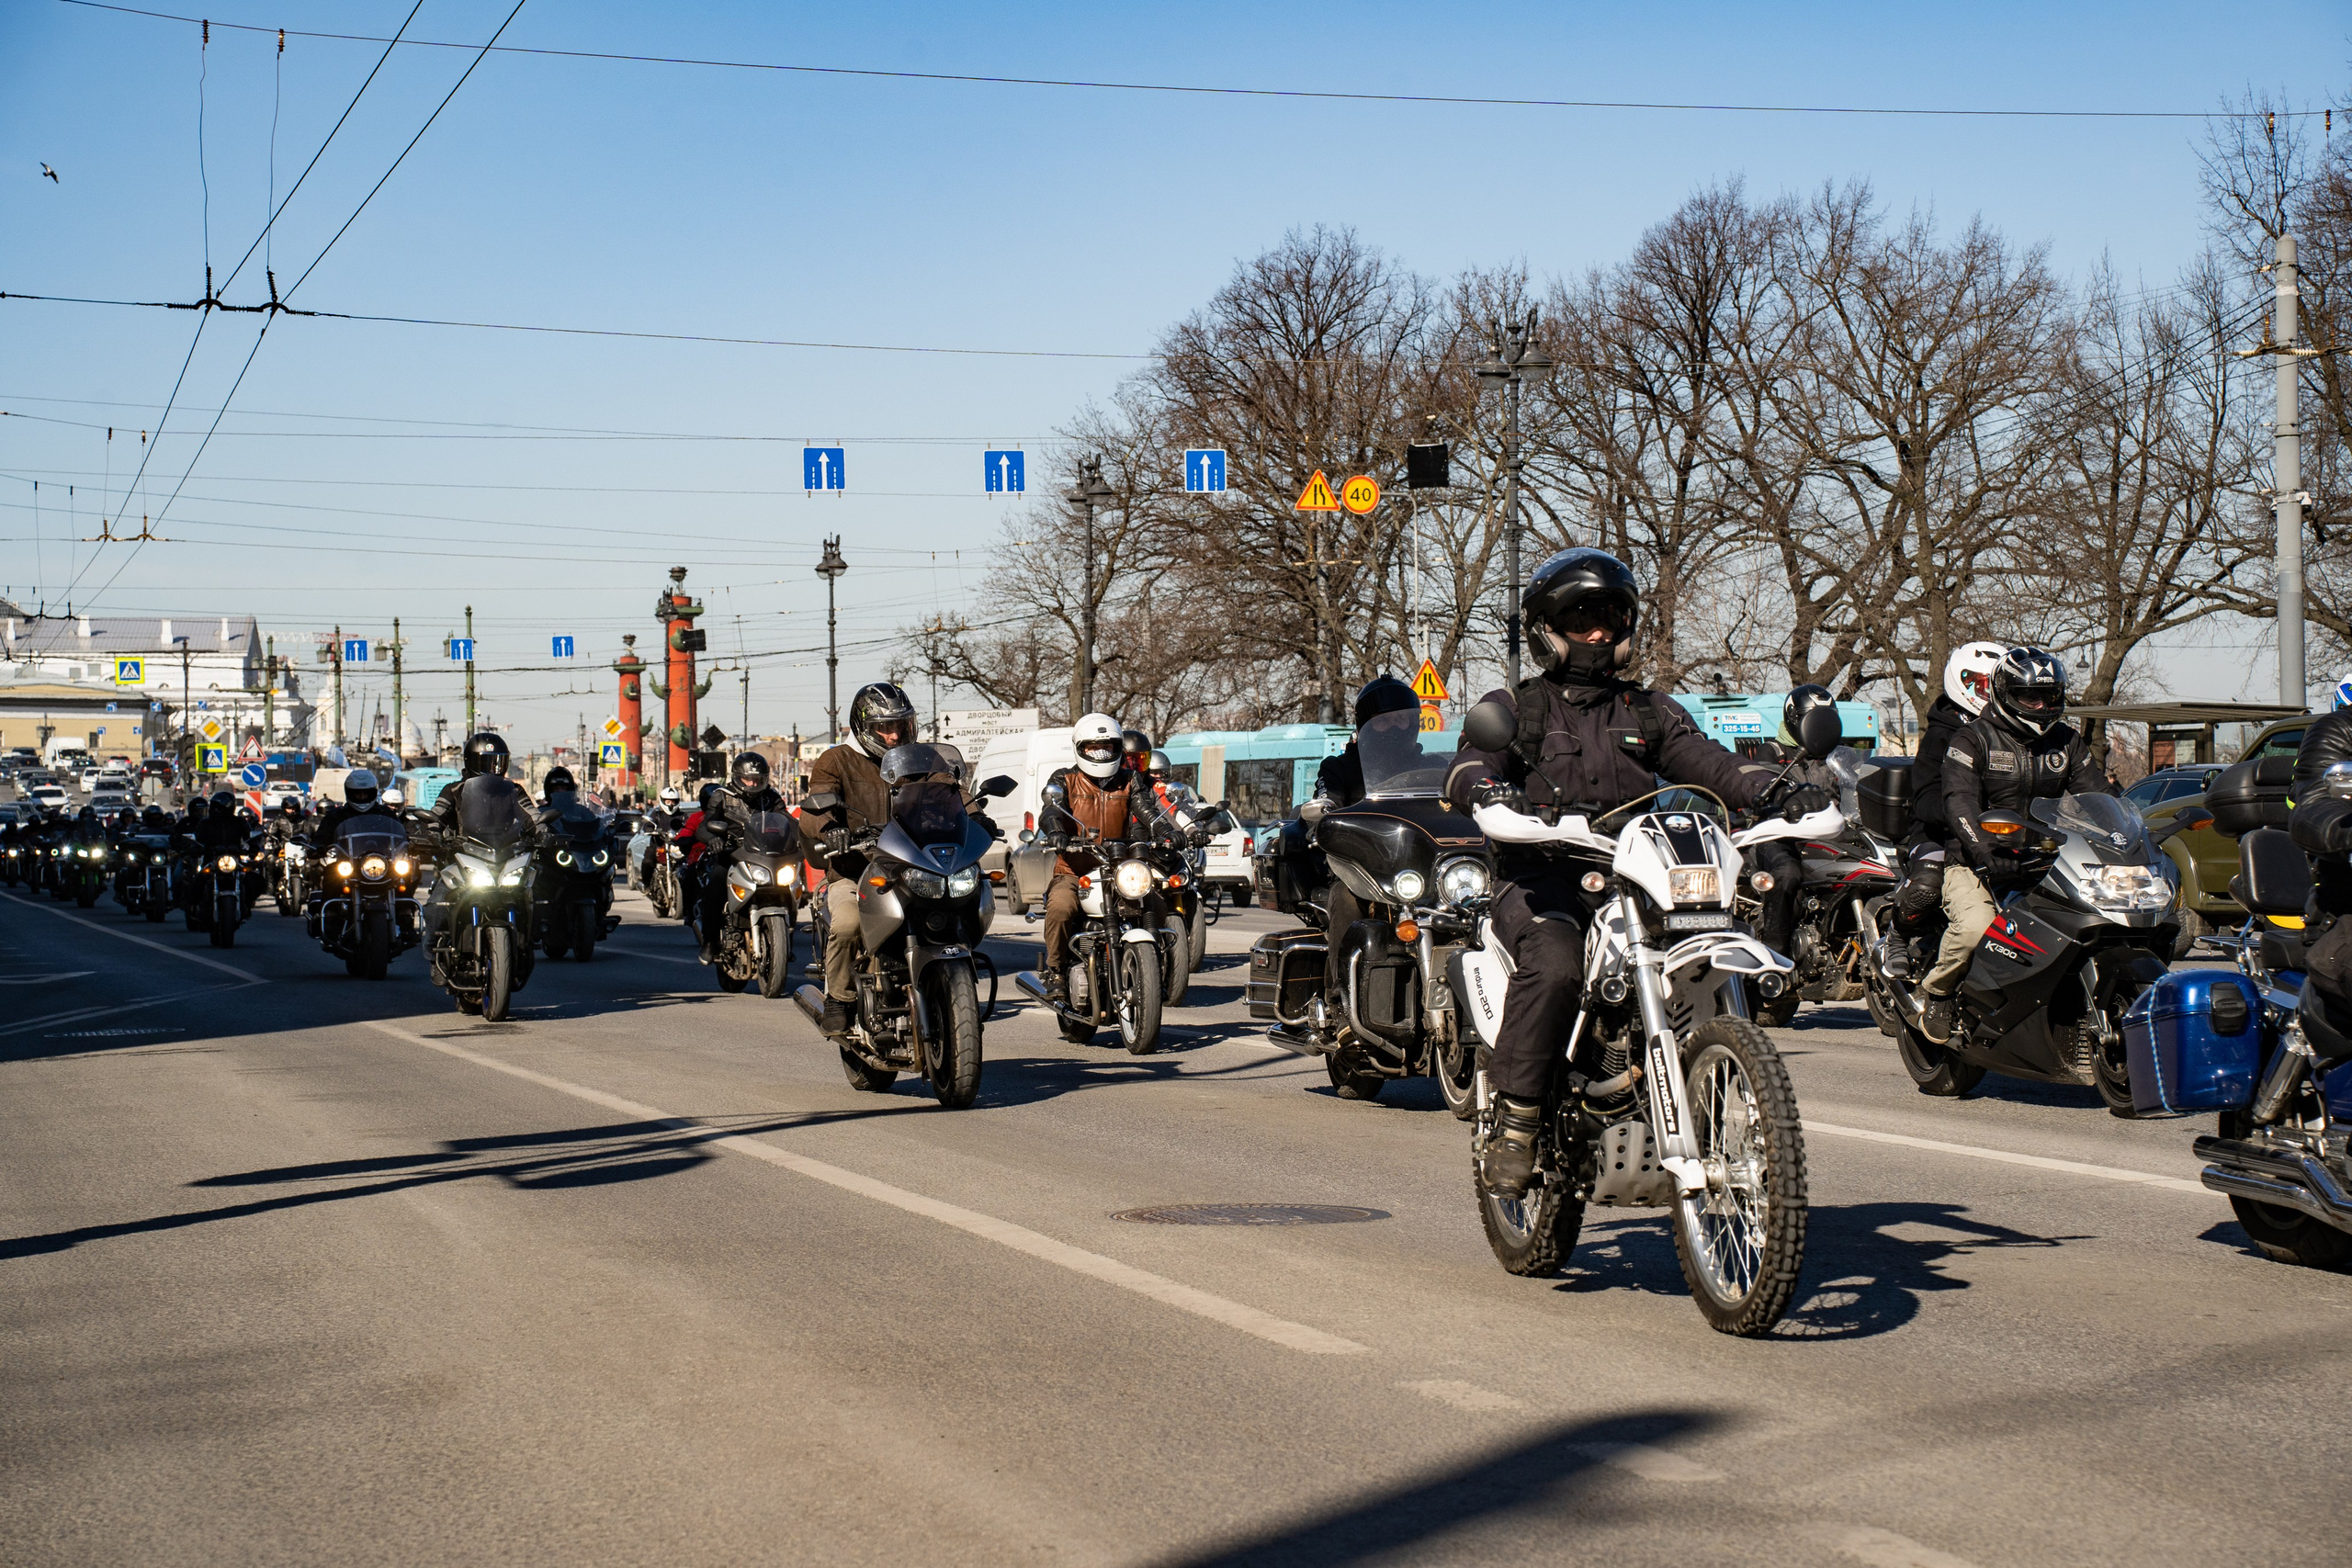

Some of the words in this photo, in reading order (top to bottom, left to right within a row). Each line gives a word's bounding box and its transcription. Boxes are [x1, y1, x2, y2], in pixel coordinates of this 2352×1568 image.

[1350, 487, 1372, 502] 40
[1724, 725, 1760, 733] 325-15-45
[1473, 966, 1484, 997] enduro
[1479, 995, 1494, 1021] 200
